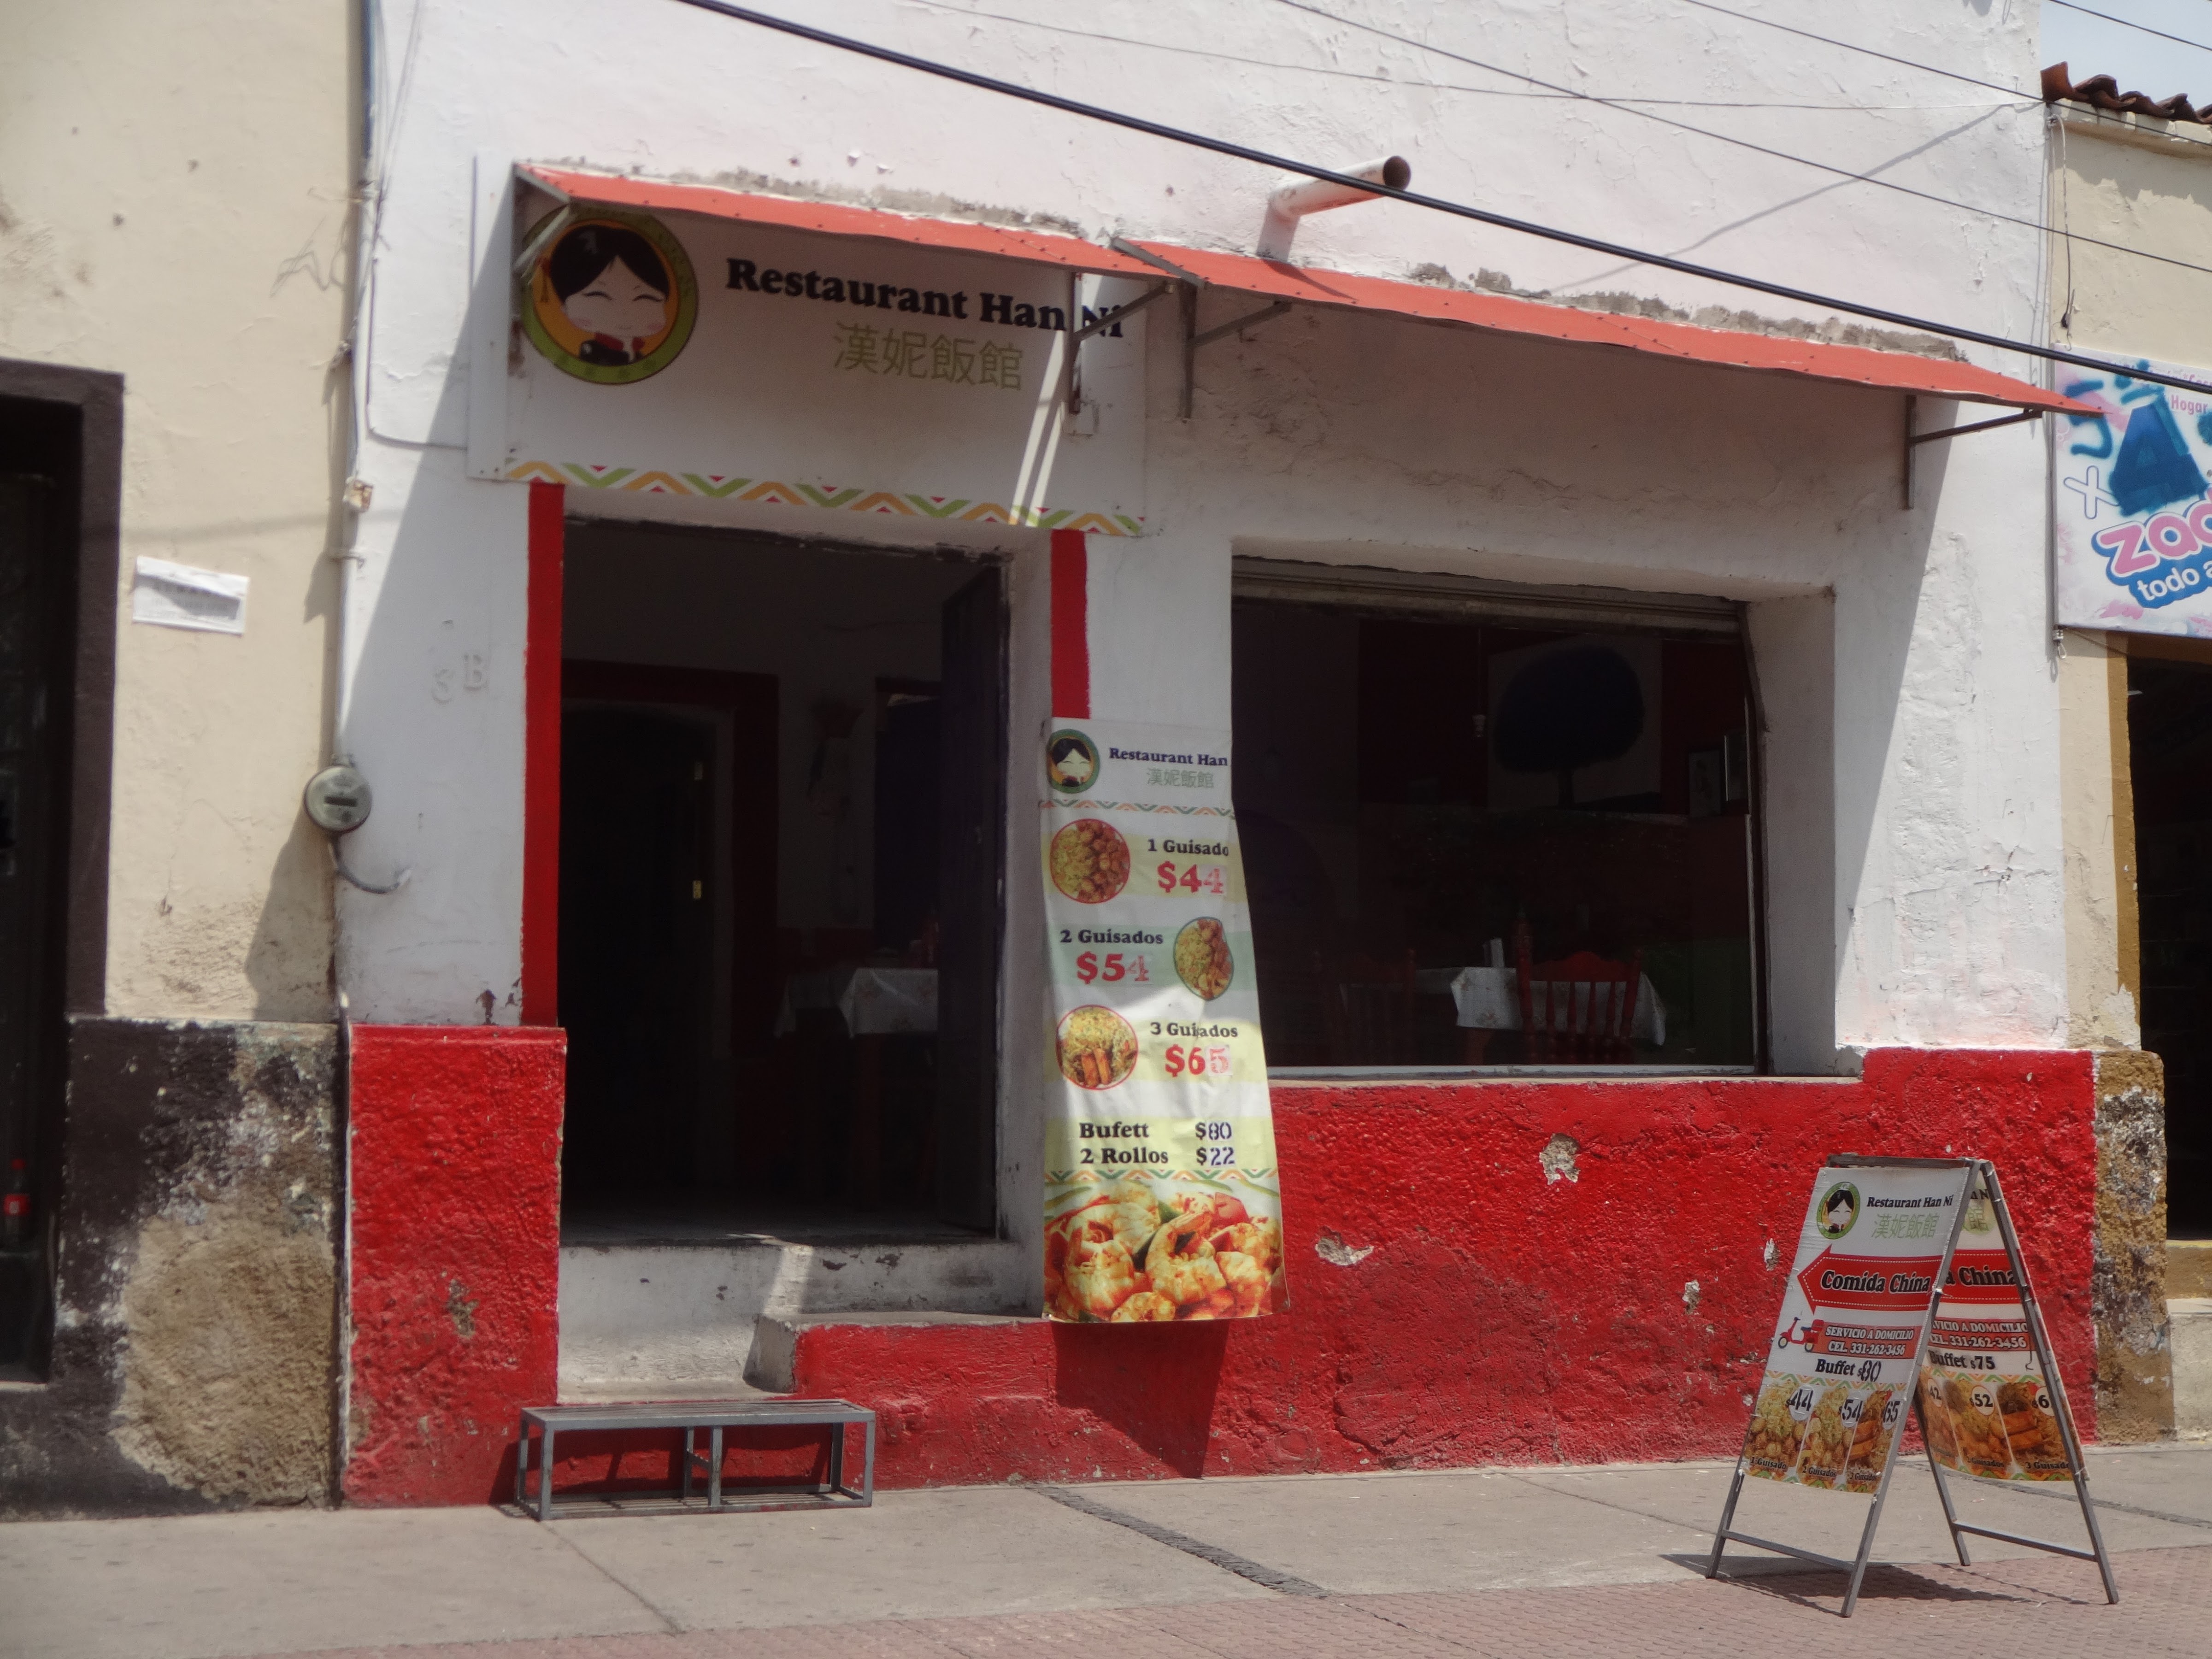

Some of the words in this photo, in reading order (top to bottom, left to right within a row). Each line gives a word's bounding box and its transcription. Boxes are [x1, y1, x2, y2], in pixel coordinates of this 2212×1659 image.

[725, 257, 968, 320] Restaurant
[979, 292, 1066, 331] Han
[1082, 305, 1123, 338] Ni
[833, 320, 1022, 390] 漢妮飯館
[2171, 394, 2208, 415] Hogar
[2136, 567, 2200, 601] todo
[1109, 747, 1194, 765] Restaurant
[1196, 753, 1228, 766] Han
[1147, 838, 1158, 852] 1
[1163, 839, 1229, 857] Guisado
[1157, 860, 1224, 894] $44
[1060, 930, 1072, 943] 2
[1077, 929, 1164, 944] Guisados
[1076, 951, 1150, 985] $54
[1150, 1021, 1161, 1035] 3
[1165, 1043, 1229, 1078] $65
[1079, 1122, 1149, 1139] Bufett
[1194, 1121, 1232, 1141] $80
[1080, 1147, 1094, 1164] 2
[1101, 1147, 1169, 1165] Rollos
[1195, 1147, 1235, 1166] $22
[1866, 1196, 1922, 1208] Restaurant
[1923, 1196, 1941, 1207] Han
[1943, 1194, 1954, 1206] Ni
[1821, 1270, 1886, 1292] Comida
[1889, 1271, 1931, 1294] China
[1959, 1265, 2016, 1285] China
[1825, 1325, 1866, 1339] SERVICIO
[1866, 1329, 1873, 1339] A
[1874, 1329, 1914, 1341] DOMICILIO
[1962, 1322, 1970, 1332] A
[1828, 1341, 1848, 1353] CEL.
[1850, 1342, 1906, 1356] 331-262-3456
[1949, 1335, 2027, 1348] 331-262-3456
[1815, 1359, 1856, 1376] Buffet
[1928, 1349, 1968, 1368] Buffet
[1971, 1355, 1996, 1370] $75
[1757, 1458, 1787, 1470] Guisado
[1808, 1466, 1837, 1478] Guisados
